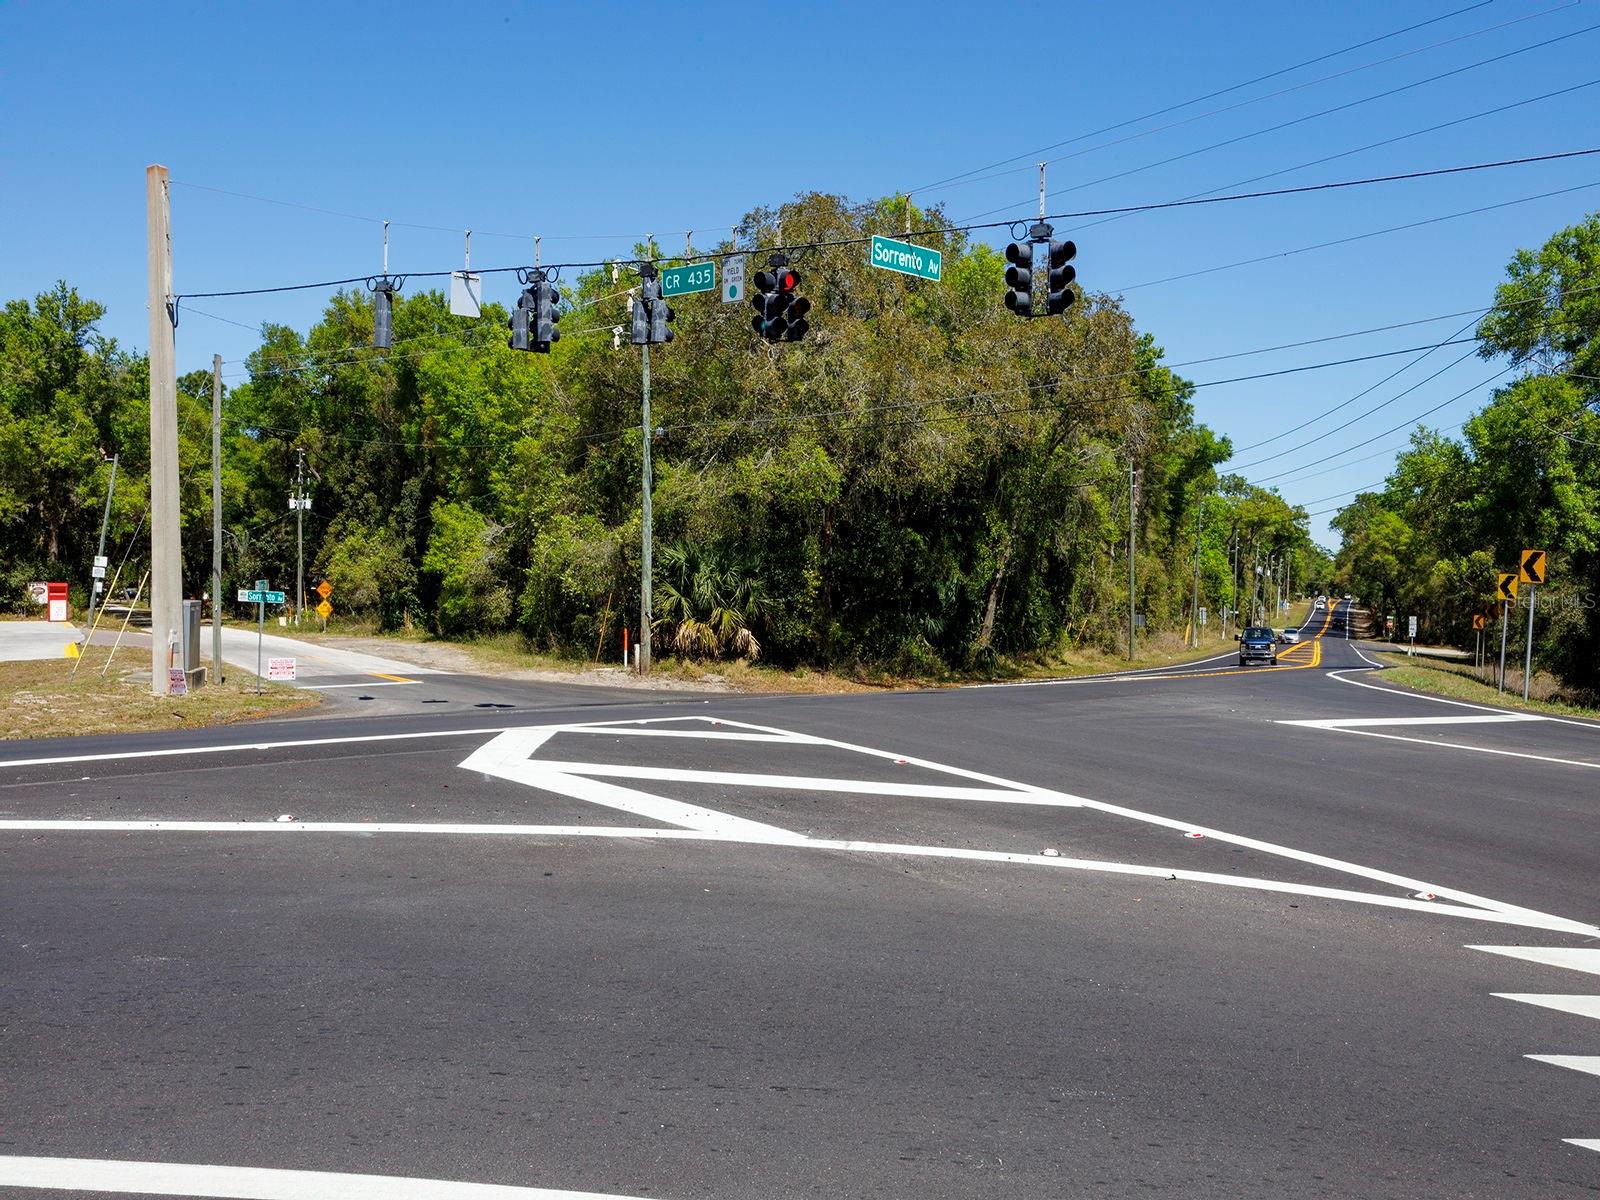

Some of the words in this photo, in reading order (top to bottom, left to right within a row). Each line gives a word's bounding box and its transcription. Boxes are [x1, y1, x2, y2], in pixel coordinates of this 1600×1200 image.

[874, 242, 923, 271] Sorrento
[927, 258, 939, 275] Av
[665, 274, 680, 290] CR
[688, 269, 711, 285] 435
[726, 266, 740, 276] YIELD
